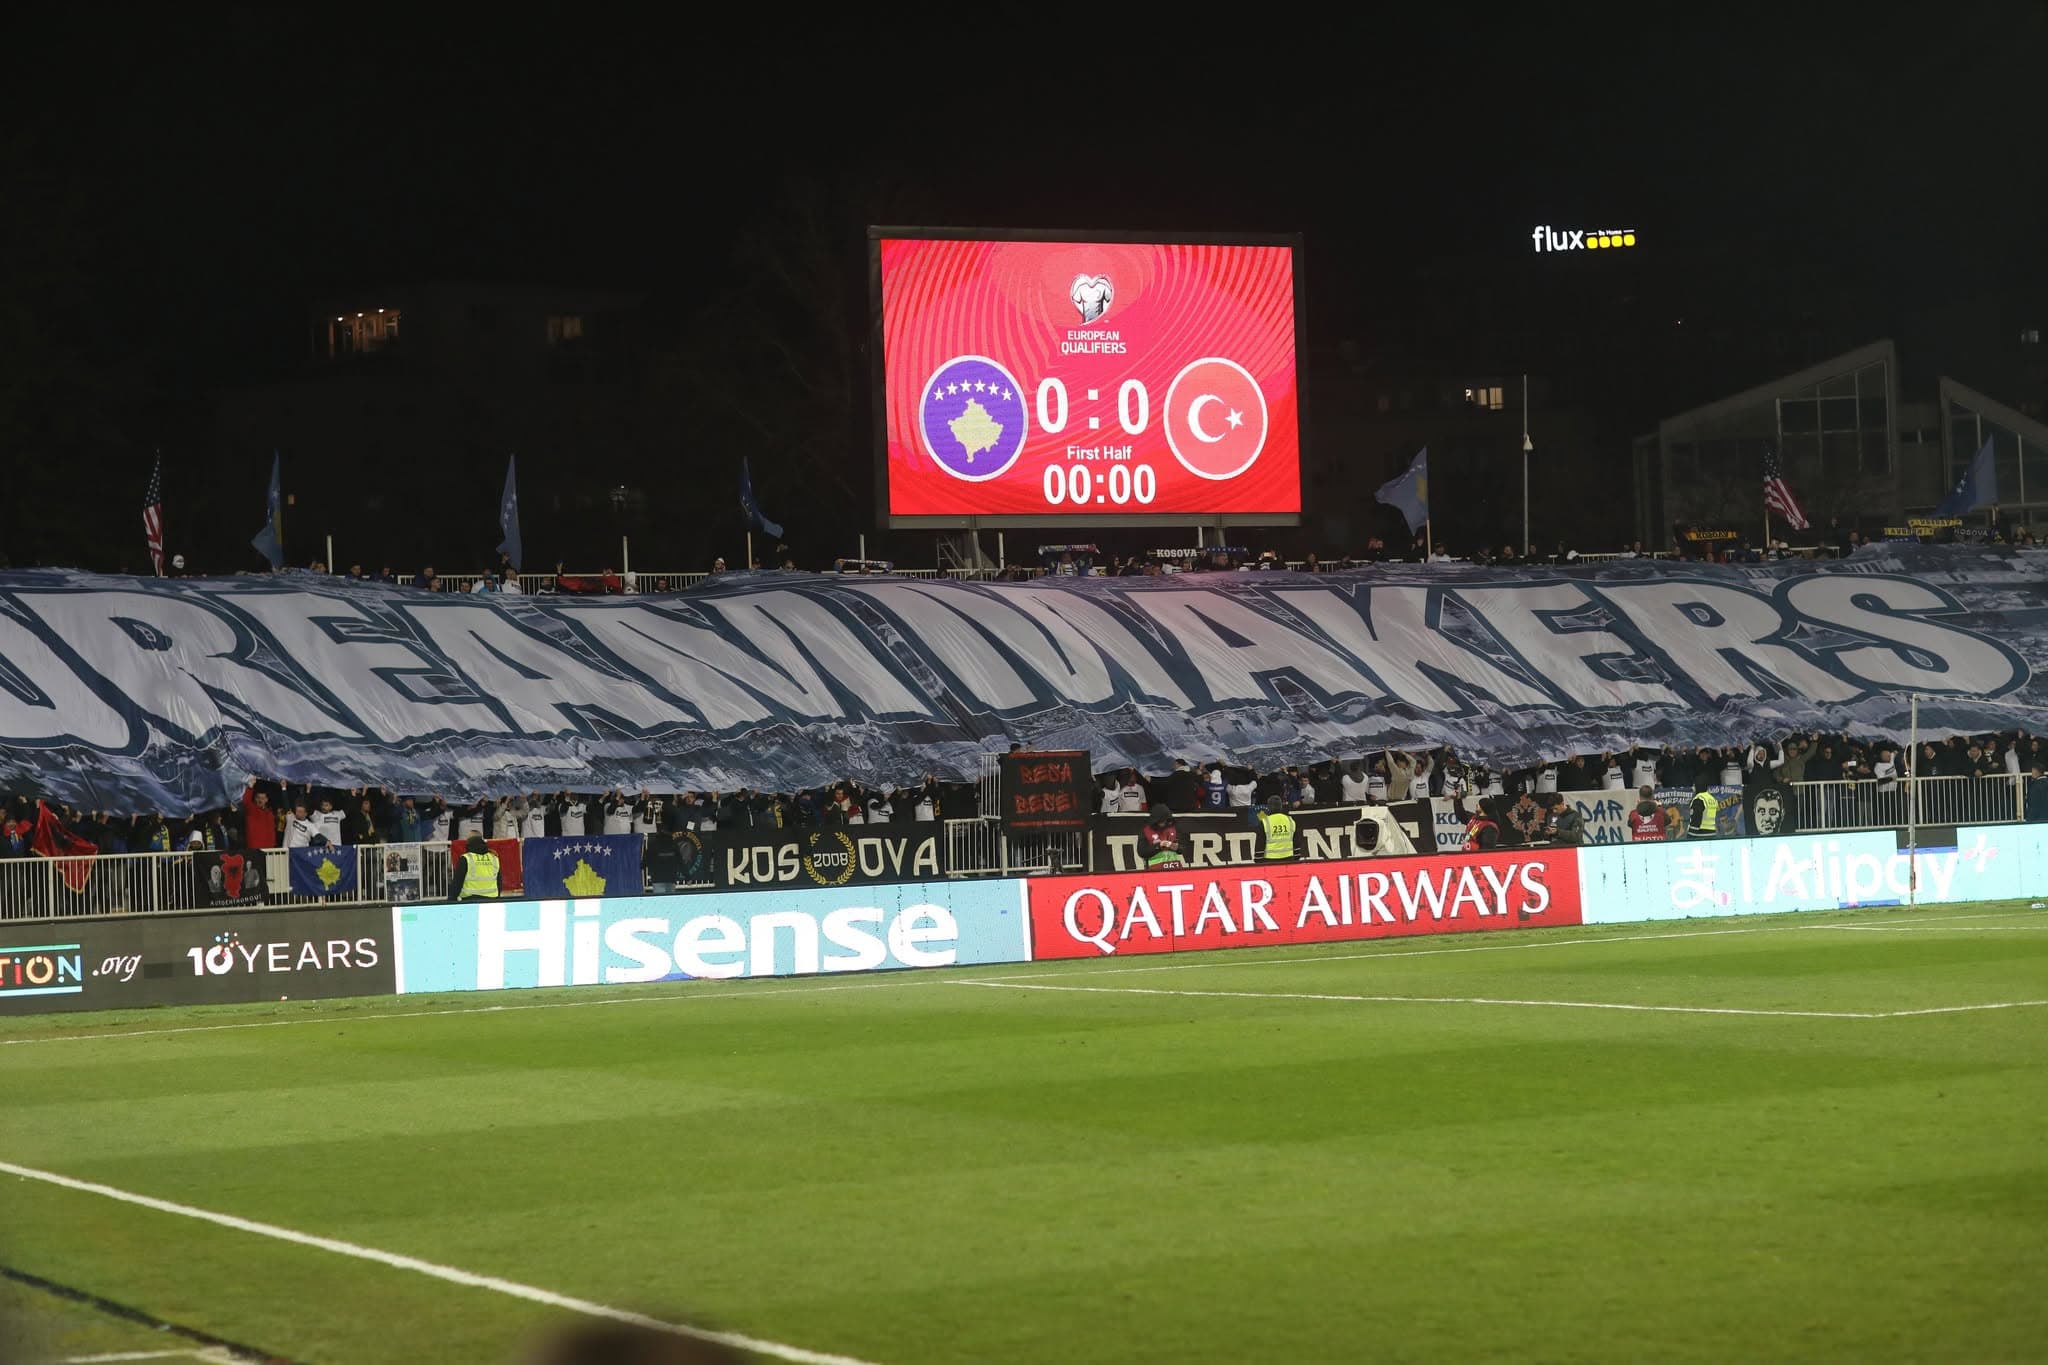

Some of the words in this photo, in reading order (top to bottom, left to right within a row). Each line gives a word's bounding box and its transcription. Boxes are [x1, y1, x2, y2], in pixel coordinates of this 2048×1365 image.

[1532, 225, 1585, 252] flux
[1061, 341, 1127, 355] QUALIFIERS
[1067, 330, 1119, 341] EUROPEAN
[1037, 377, 1069, 433] 0
[1118, 379, 1149, 435] 0
[1067, 445, 1100, 460] First
[1103, 445, 1132, 460] Half
[1043, 464, 1156, 504] 00:00
[1157, 548, 1197, 558] KOSOVA
[1211, 791, 1222, 805] 9
[1273, 825, 1288, 833] 231
[727, 842, 800, 886] KOS
[813, 853, 849, 868] 2008
[857, 836, 940, 877] OVA
[1062, 878, 1279, 954] QATAR
[1297, 862, 1550, 928] AIRWAYS
[476, 900, 959, 990] Hisense
[92, 955, 142, 982] .org
